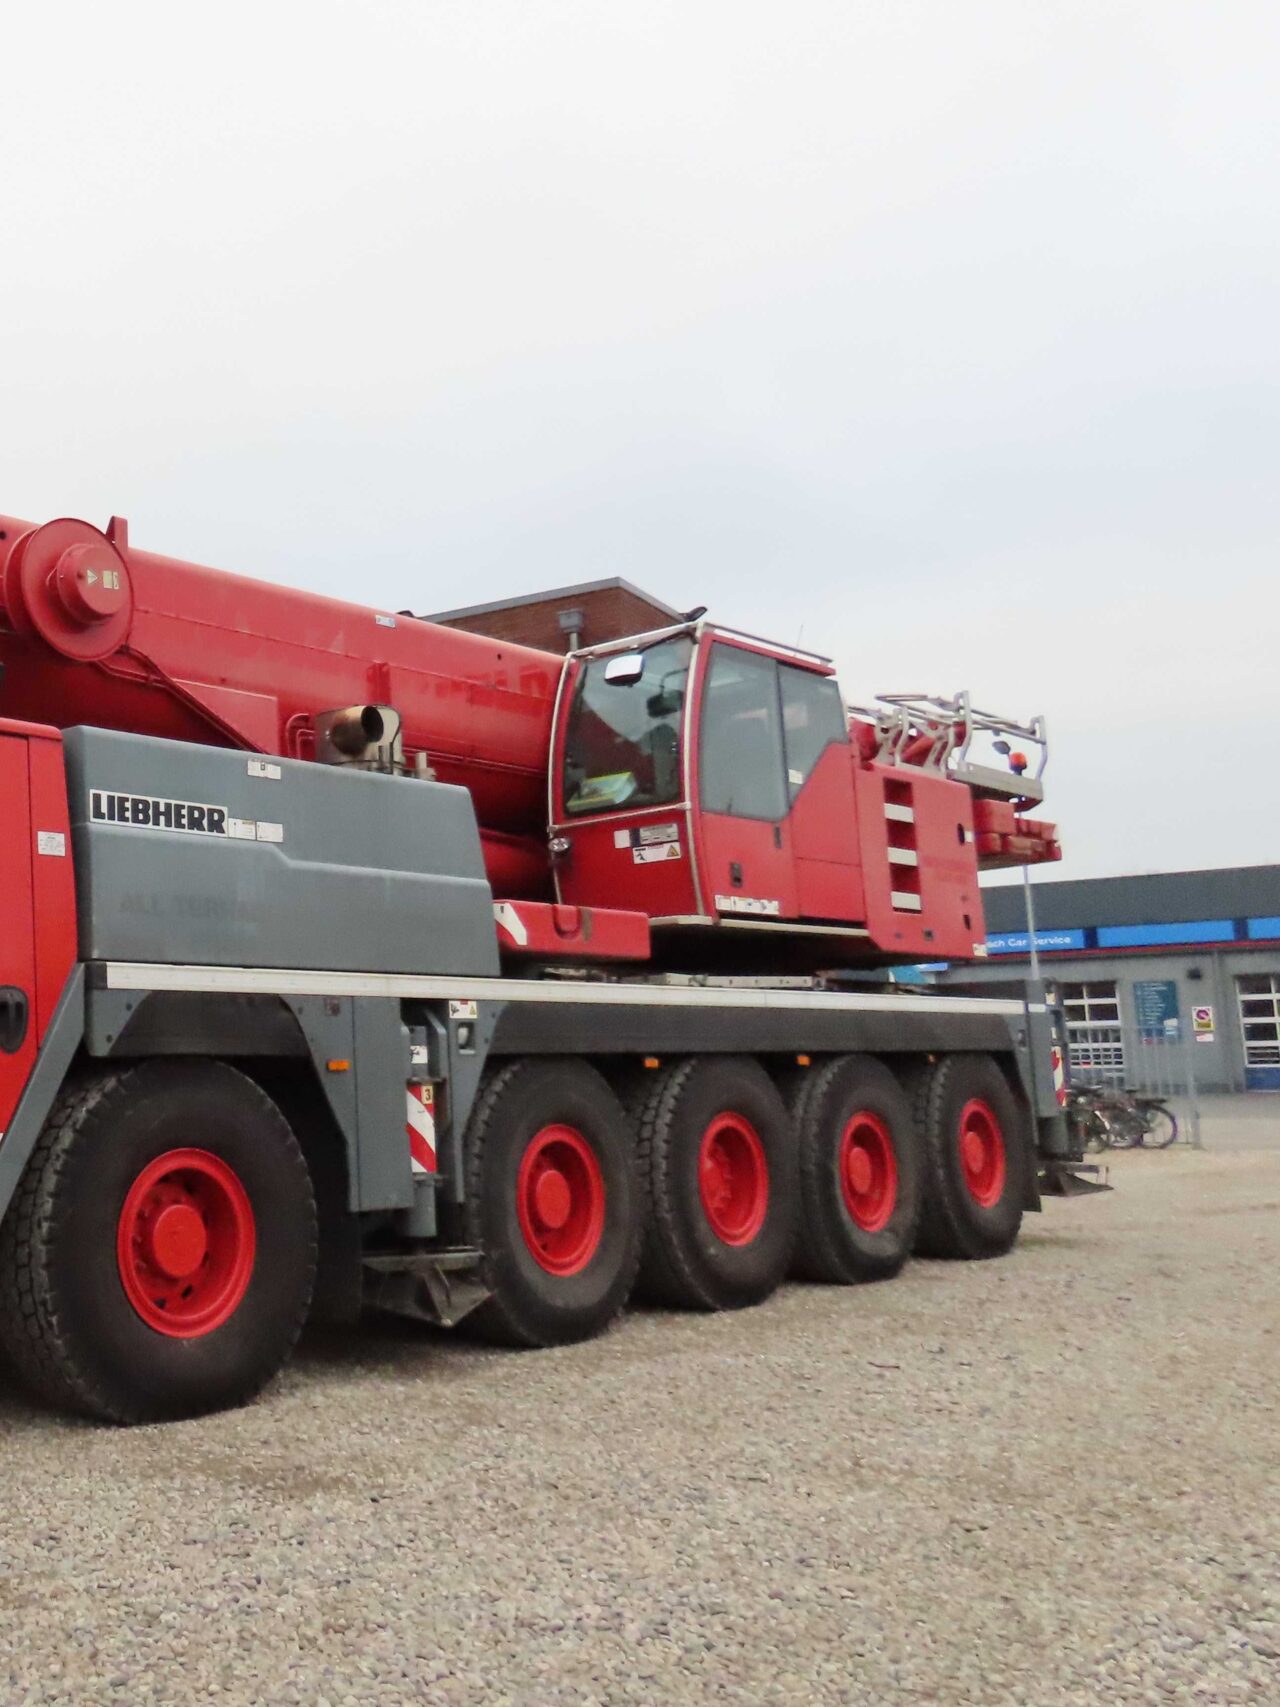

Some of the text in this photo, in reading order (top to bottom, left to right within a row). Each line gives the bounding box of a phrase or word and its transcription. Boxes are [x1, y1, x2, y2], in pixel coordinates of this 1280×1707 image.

[92, 792, 226, 834] LIEBHERR
[1008, 938, 1027, 947] Car
[425, 1088, 431, 1101] 3
